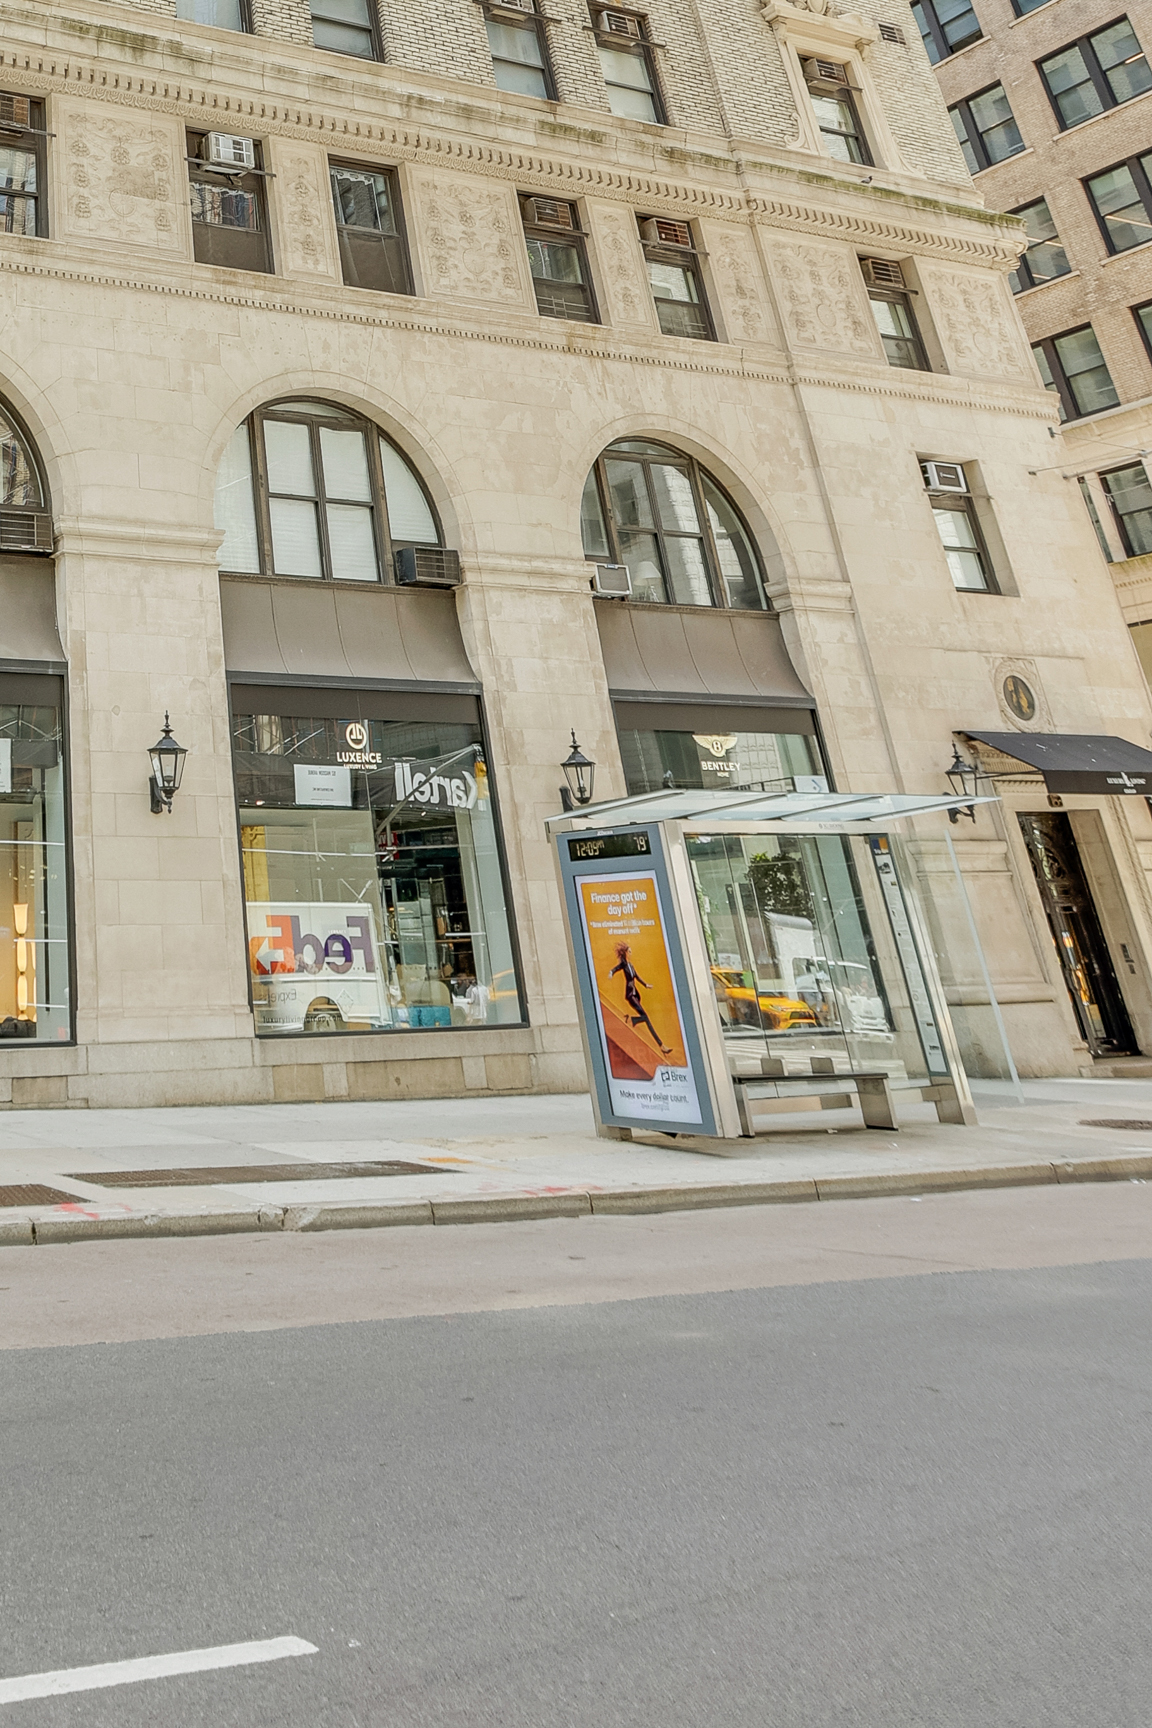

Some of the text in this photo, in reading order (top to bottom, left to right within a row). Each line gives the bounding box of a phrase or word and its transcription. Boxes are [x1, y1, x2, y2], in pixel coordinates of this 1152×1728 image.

[336, 752, 382, 763] LUXENCE
[701, 761, 741, 771] BENTLEY
[590, 890, 647, 904] Finance got the
[607, 904, 621, 917] day
[671, 1072, 688, 1083] Brex
[619, 1089, 689, 1103] Make every dollar count.
